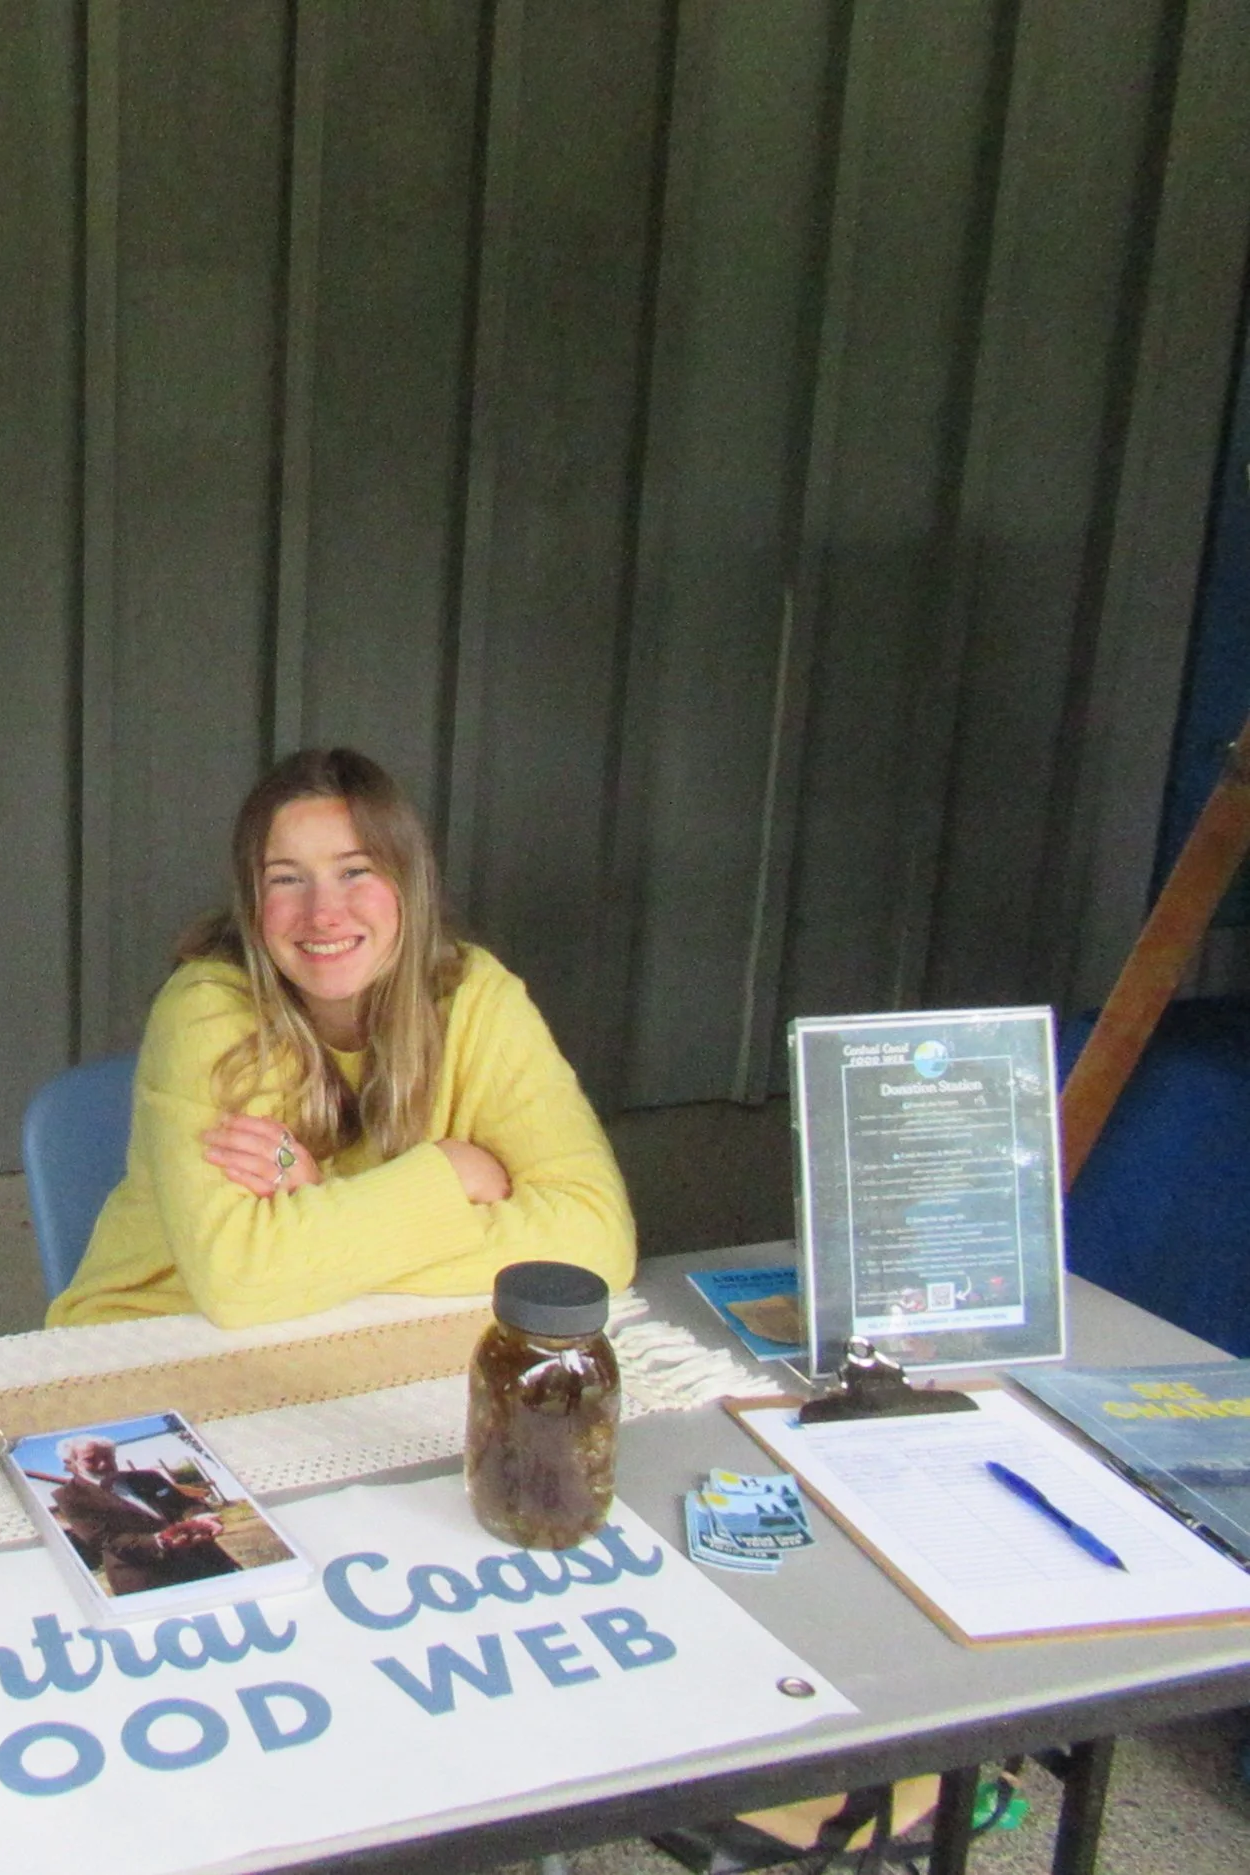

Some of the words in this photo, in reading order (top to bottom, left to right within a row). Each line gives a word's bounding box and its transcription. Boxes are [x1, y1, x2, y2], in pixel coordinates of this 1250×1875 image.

[879, 1080, 937, 1097] Donation
[938, 1078, 983, 1093] Station
[322, 1522, 664, 1631] Coast
[371, 1607, 677, 1717] WEB
